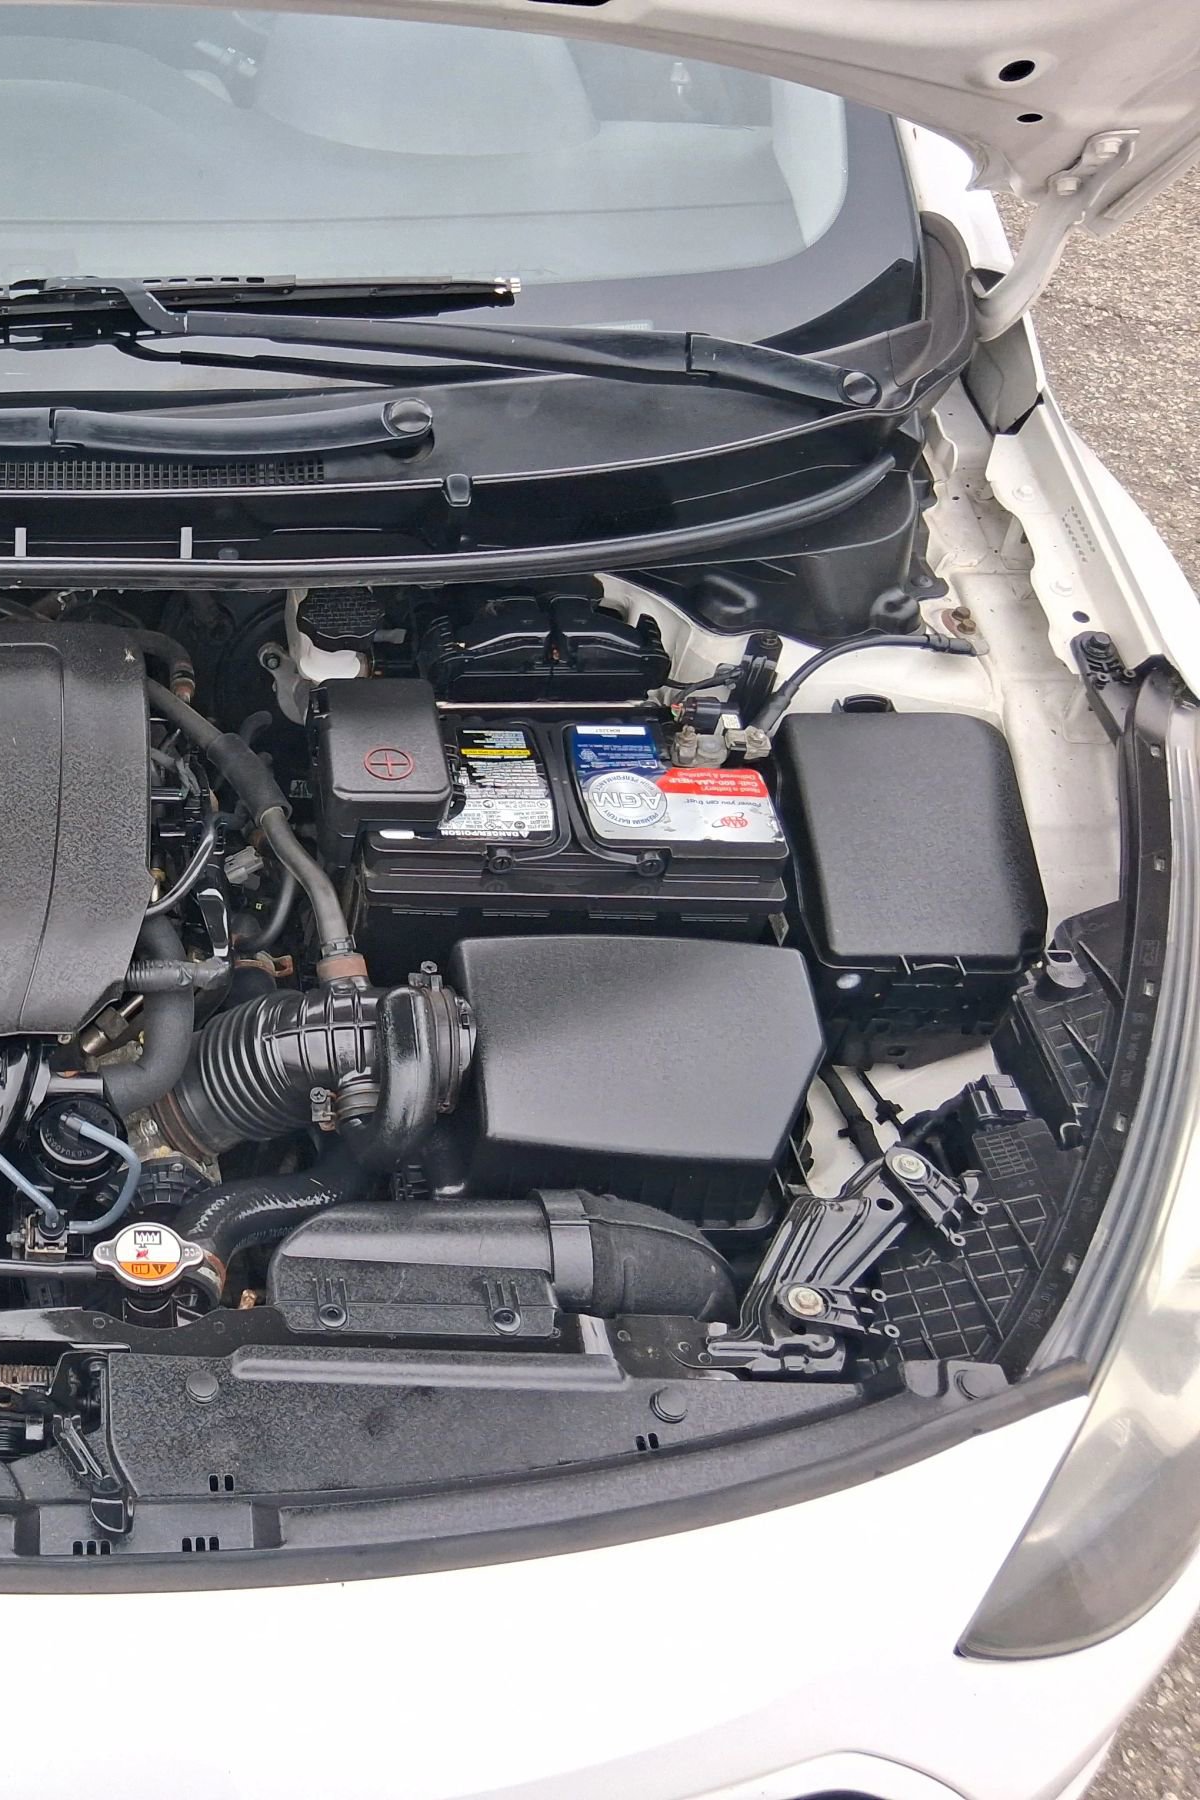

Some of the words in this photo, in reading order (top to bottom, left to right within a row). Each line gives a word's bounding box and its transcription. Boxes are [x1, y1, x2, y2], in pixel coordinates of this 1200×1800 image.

[592, 791, 662, 811] AGM
[603, 808, 631, 825] BATTERY
[632, 812, 659, 825] PREMIUM
